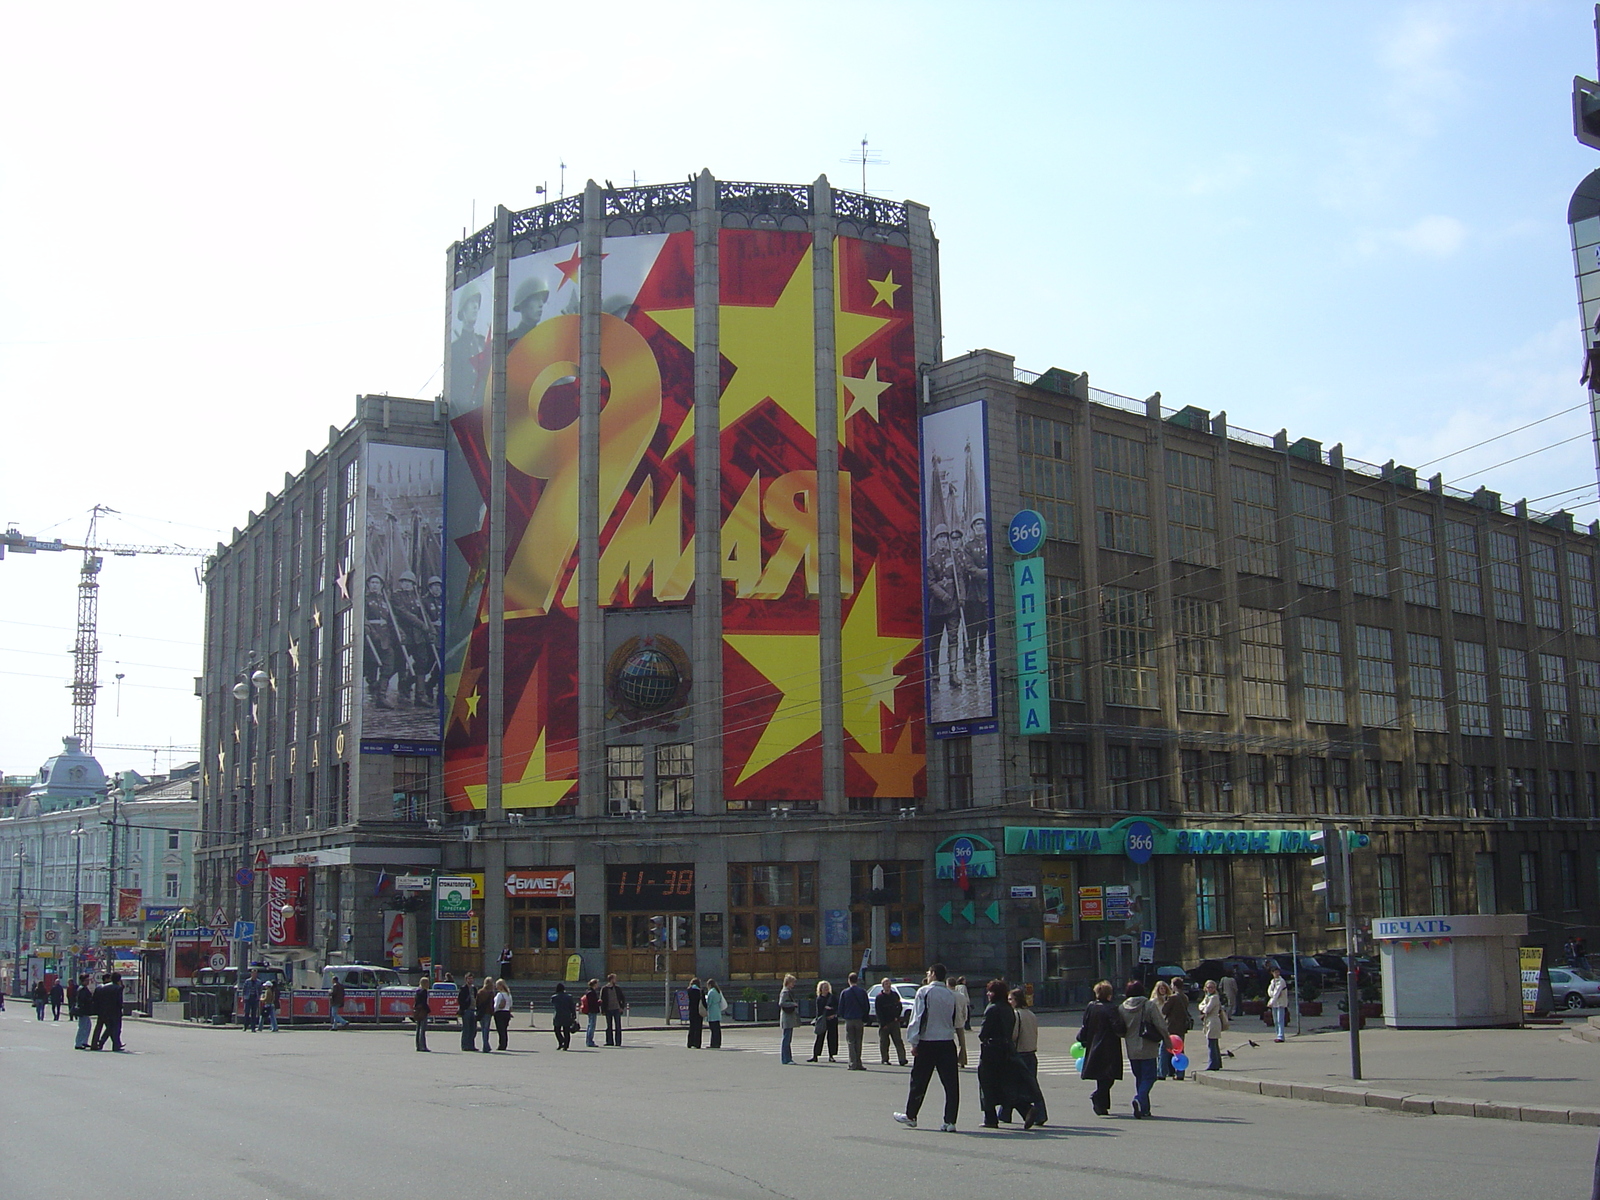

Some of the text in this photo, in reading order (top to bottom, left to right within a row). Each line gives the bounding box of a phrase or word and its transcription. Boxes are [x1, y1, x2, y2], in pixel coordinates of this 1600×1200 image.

[480, 312, 854, 622] 9 МАЯ
[1020, 565, 1041, 730] АПТЕКА
[1022, 829, 1101, 851] АПТЕКА
[1176, 831, 1271, 854] ЗДОРОВЬЕ
[515, 877, 559, 890] БИЛЕТ
[1378, 920, 1452, 935] ПЕЧАТЬ
[212, 957, 224, 966] 60
